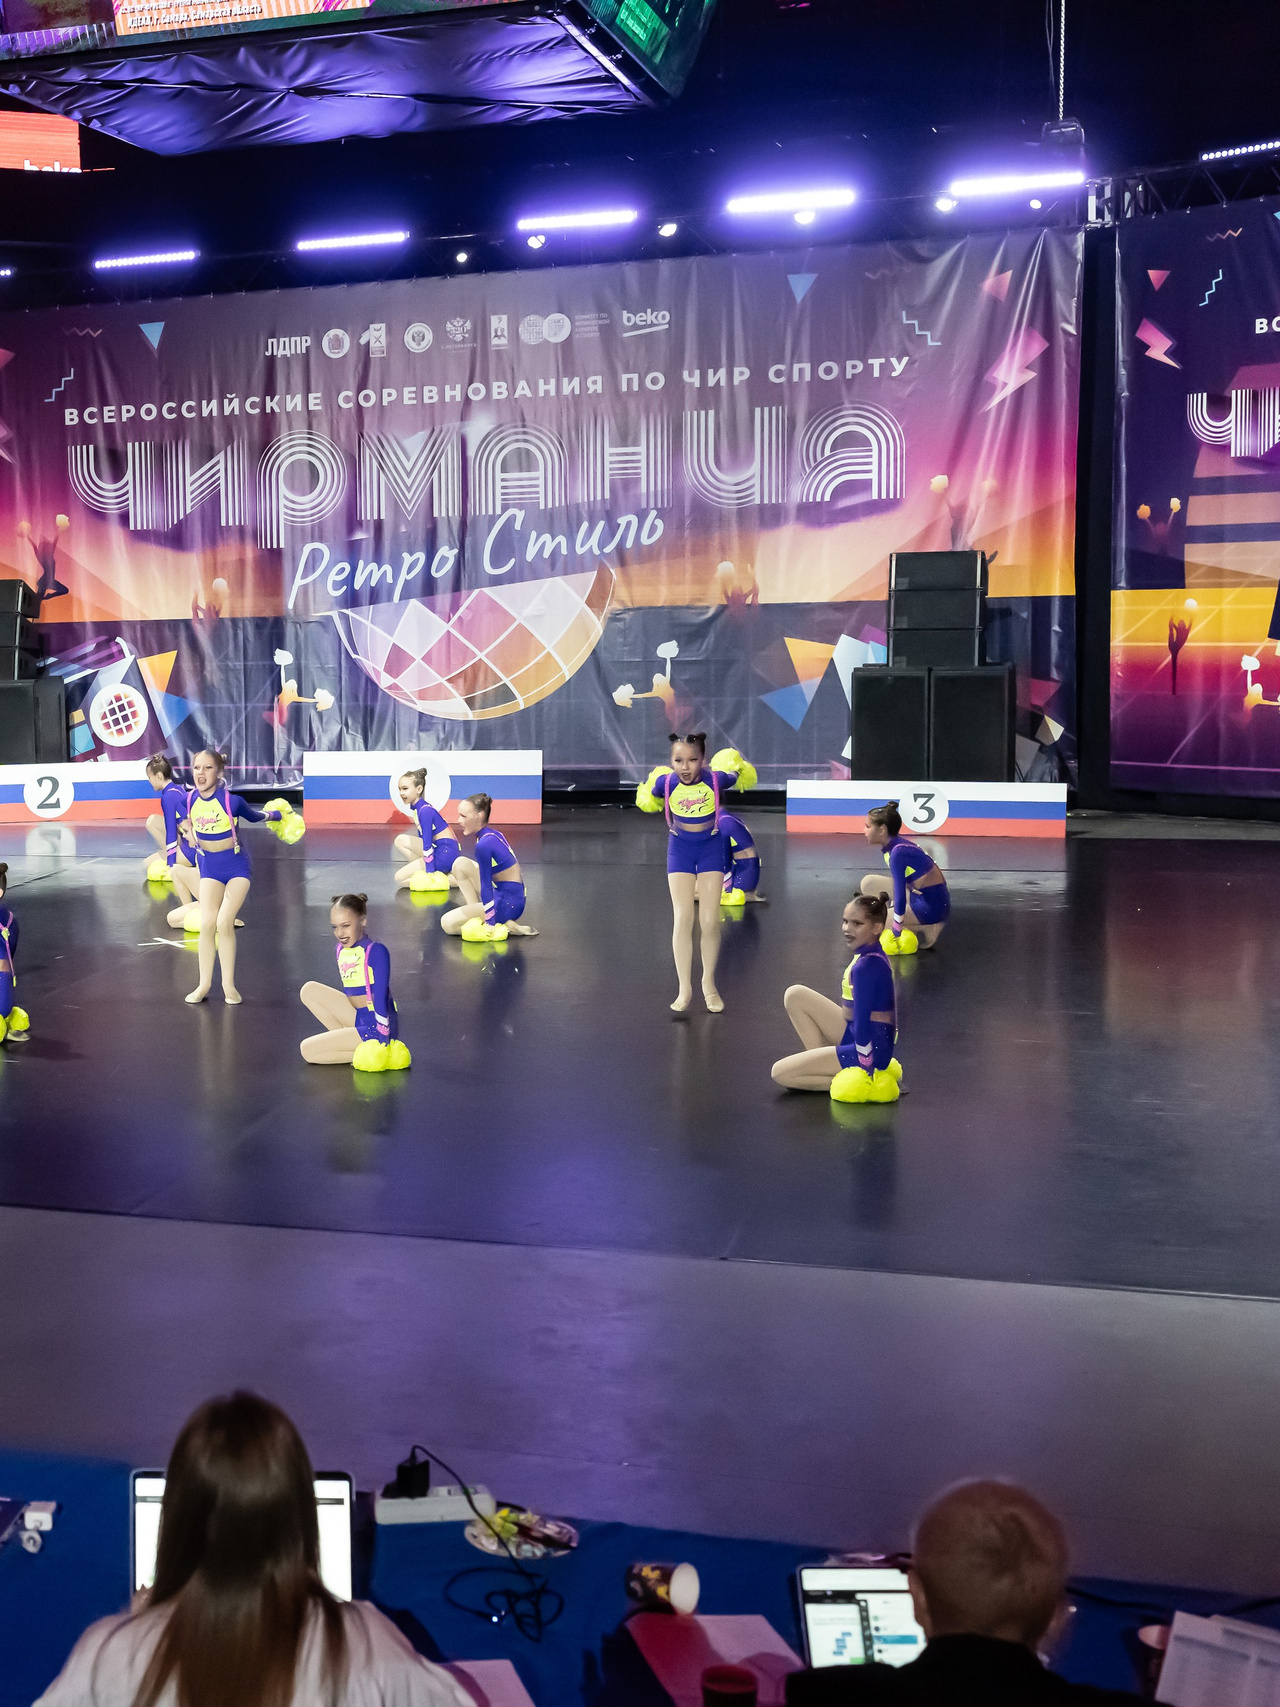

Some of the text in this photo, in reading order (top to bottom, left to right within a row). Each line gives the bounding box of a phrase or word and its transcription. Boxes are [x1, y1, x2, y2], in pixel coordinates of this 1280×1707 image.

[622, 308, 671, 327] beko
[264, 335, 312, 358] ЛДПР
[64, 356, 910, 426] ВСЕРОССИЙСКИЕ СОРЕВНОВАНИЯ ПО ЧИР СПОРТУ
[287, 507, 665, 610] Ретро Стиль
[36, 775, 61, 809] 2
[911, 793, 936, 824] 3
